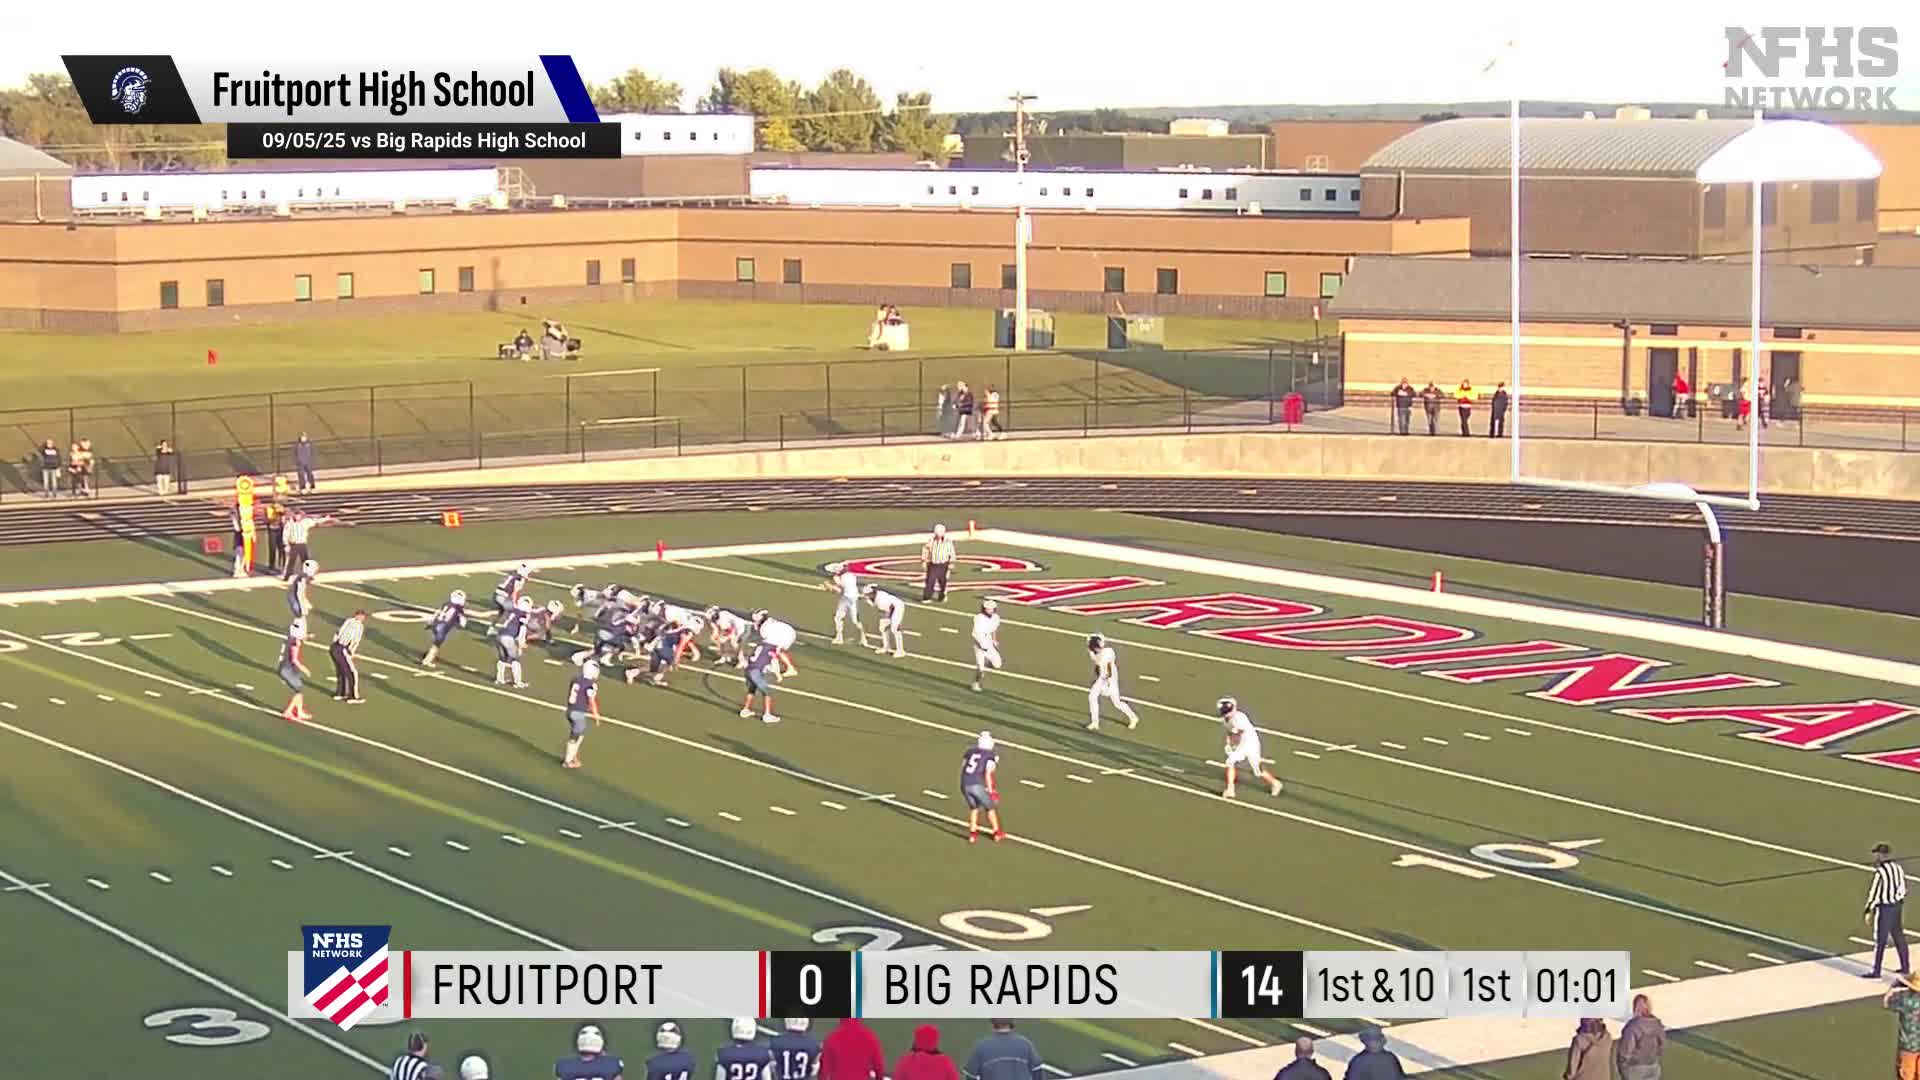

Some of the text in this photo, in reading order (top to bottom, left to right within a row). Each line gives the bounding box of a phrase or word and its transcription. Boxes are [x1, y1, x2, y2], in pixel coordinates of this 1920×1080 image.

[845, 554, 1920, 772] CARDINA
[965, 753, 981, 774] 5
[1392, 840, 1580, 879] 10
[782, 1050, 809, 1080] 13
